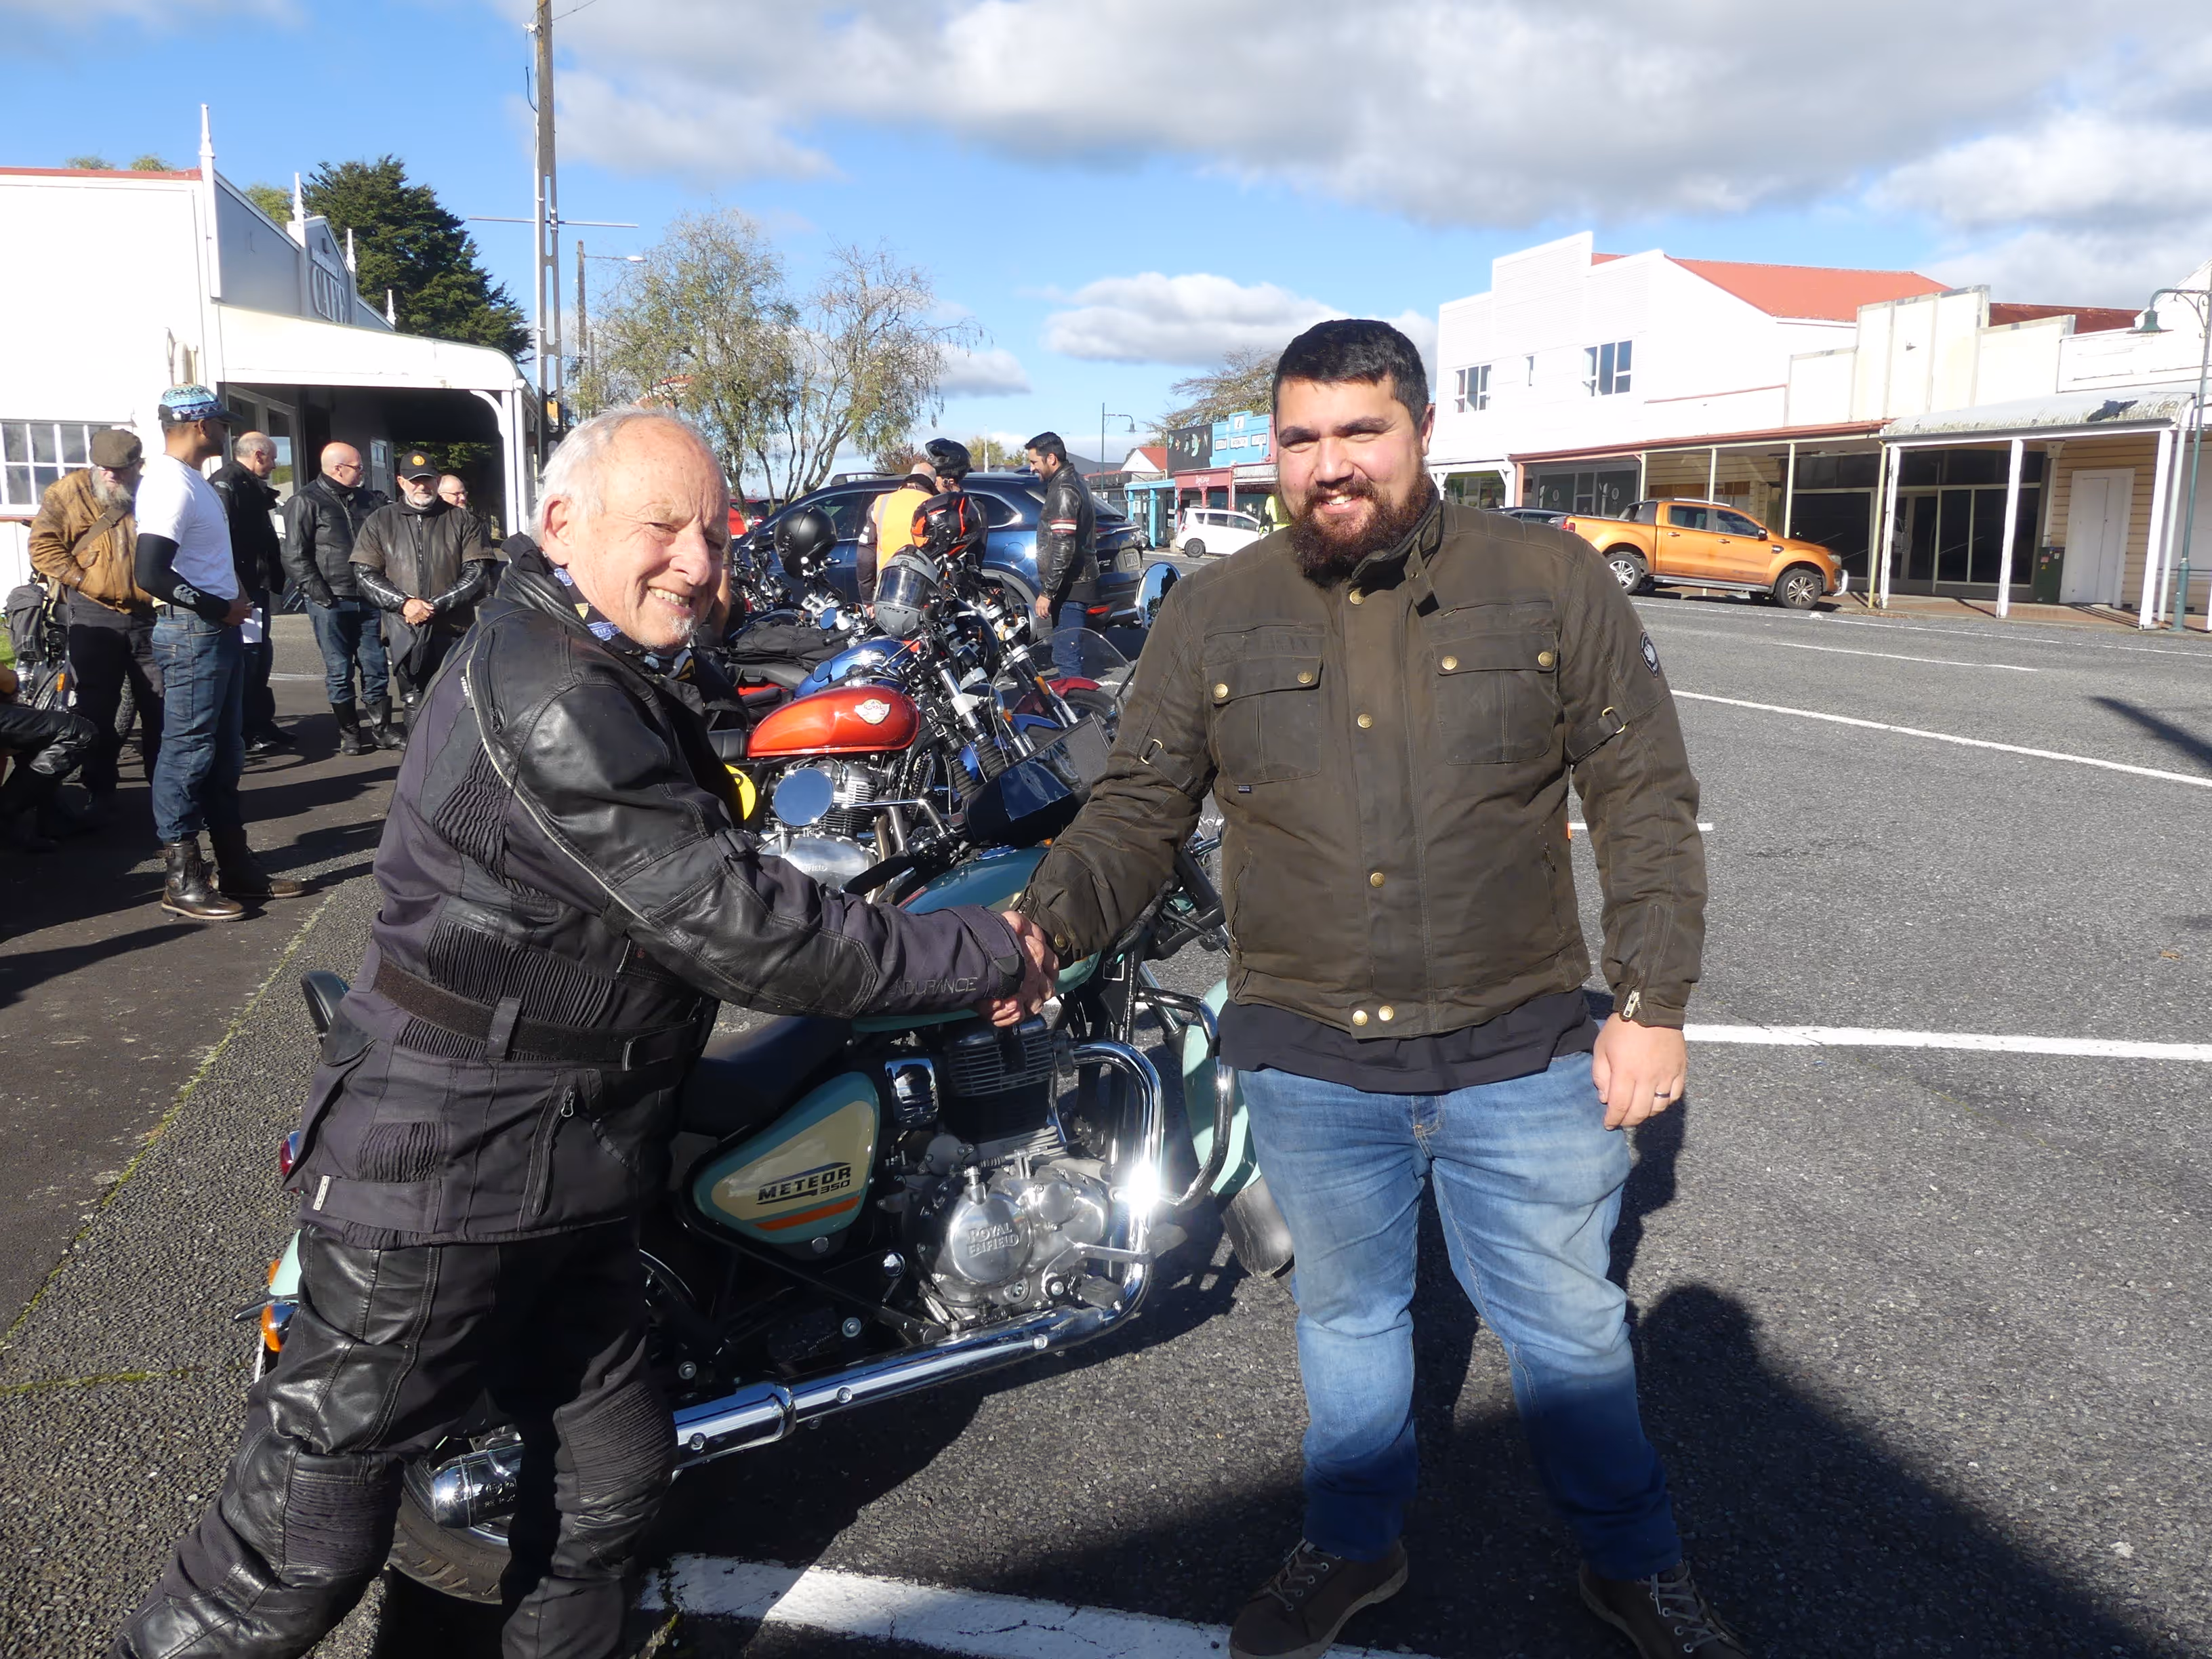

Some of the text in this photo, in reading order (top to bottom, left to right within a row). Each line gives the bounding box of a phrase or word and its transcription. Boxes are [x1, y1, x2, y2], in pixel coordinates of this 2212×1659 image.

[461, 676, 470, 697] VENT
[758, 1166, 852, 1201] METEOR
[820, 1179, 851, 1195] 350
[968, 1222, 1012, 1244] ROYAL
[967, 1234, 1019, 1258] ENFIELD
